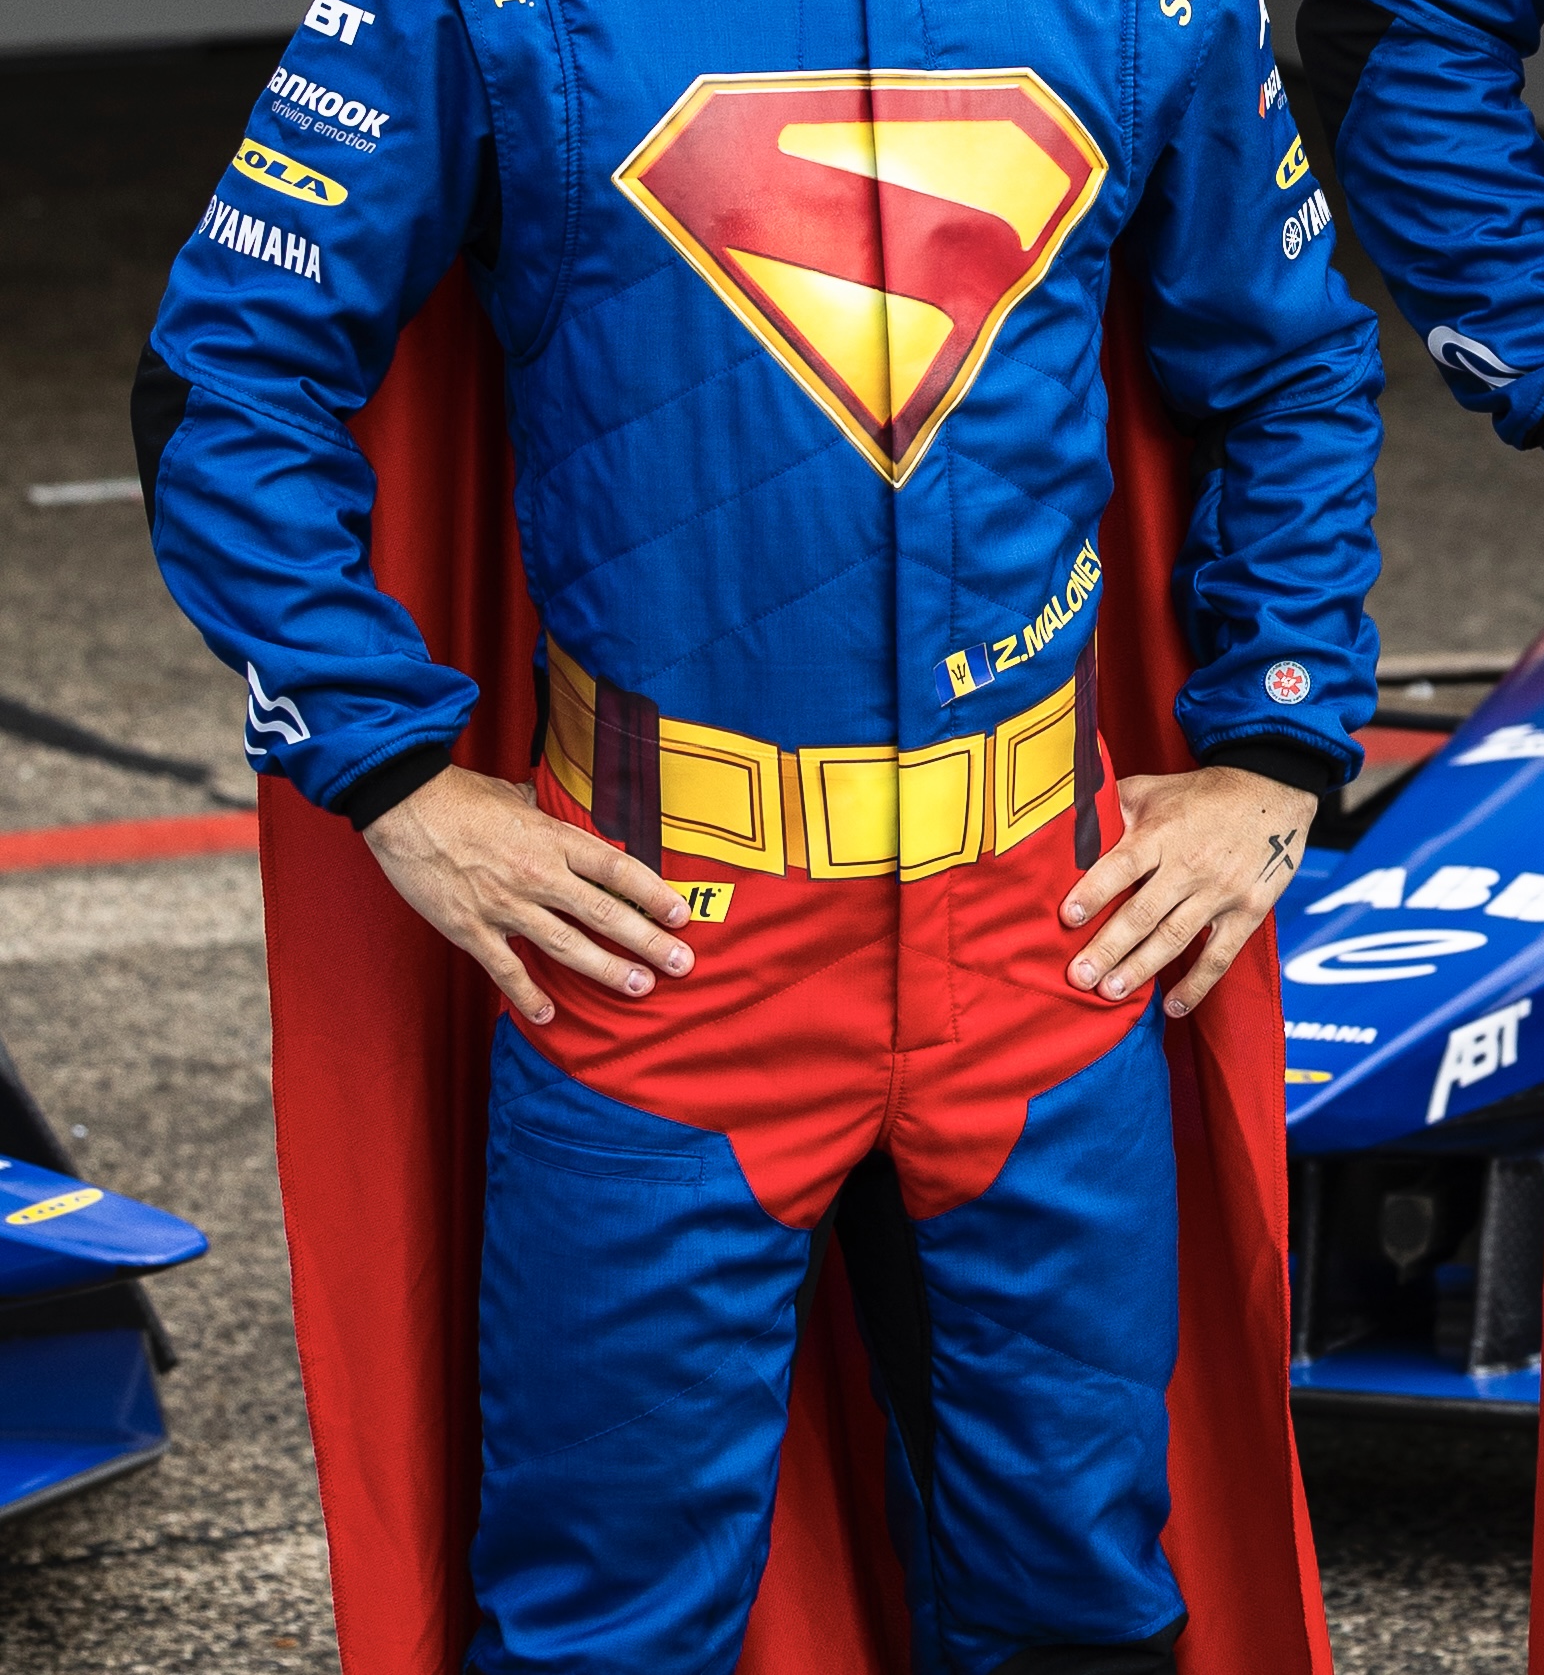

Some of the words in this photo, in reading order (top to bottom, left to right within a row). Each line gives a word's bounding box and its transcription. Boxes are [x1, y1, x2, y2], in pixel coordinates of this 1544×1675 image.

[271, 99, 314, 131] driving
[313, 120, 377, 154] emotion
[208, 200, 321, 284] YAMAHA
[992, 537, 1102, 673] Z.MALONEY
[1426, 997, 1532, 1125] ABT
